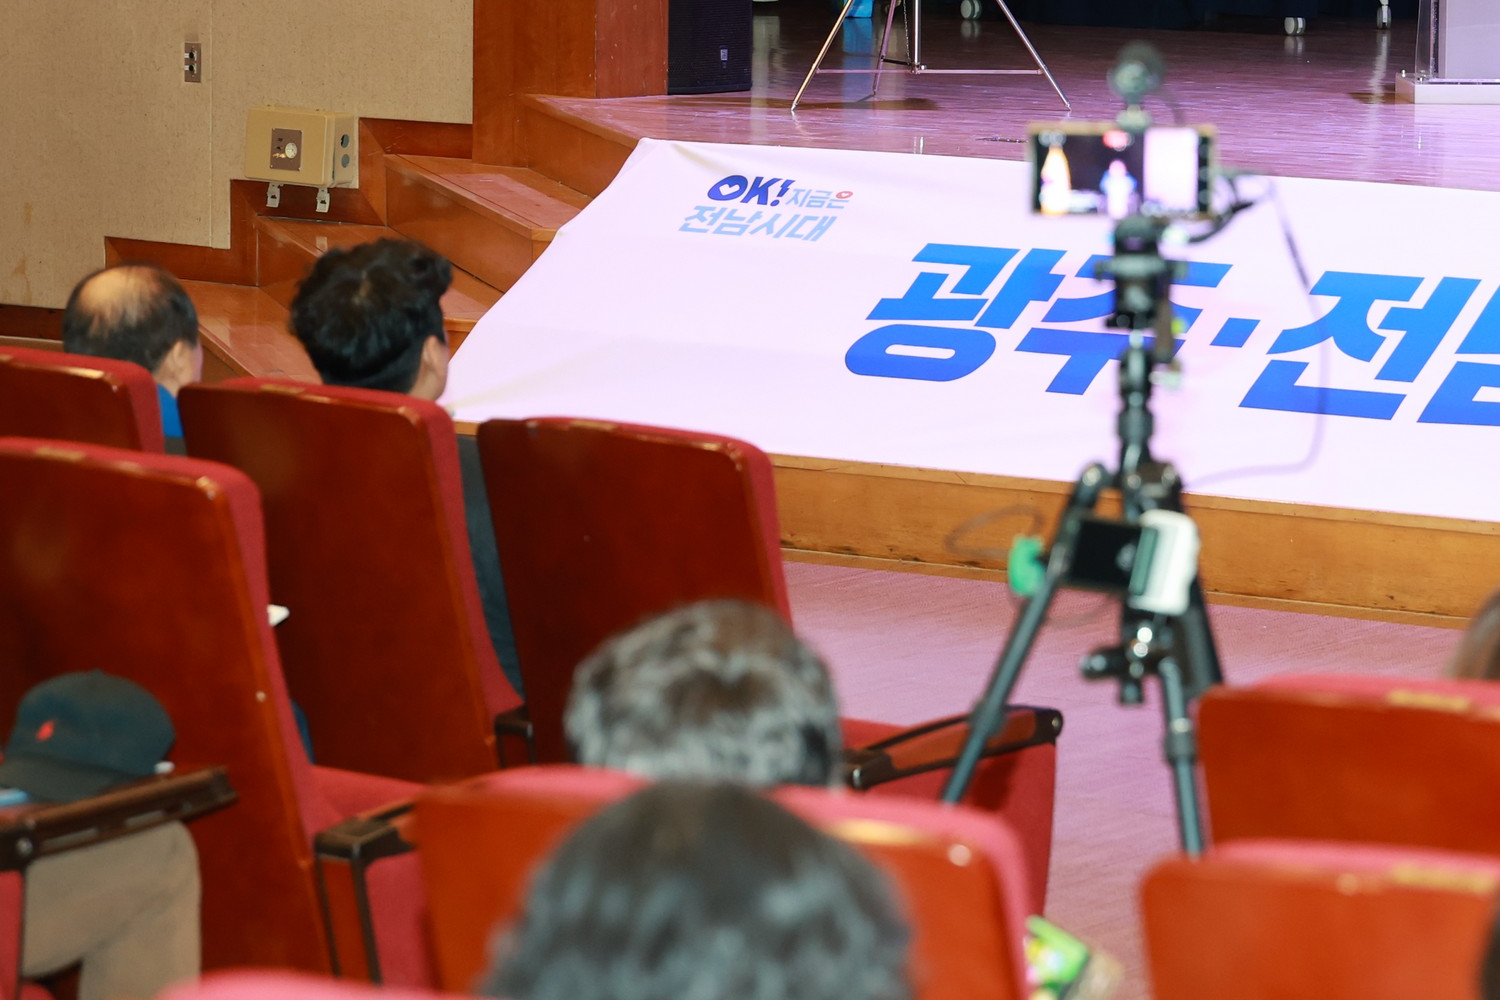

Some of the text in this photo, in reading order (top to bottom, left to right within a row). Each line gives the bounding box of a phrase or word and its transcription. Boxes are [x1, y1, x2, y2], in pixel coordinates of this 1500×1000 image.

[707, 174, 854, 210] OK! 지금은
[678, 205, 838, 242] 전남시대
